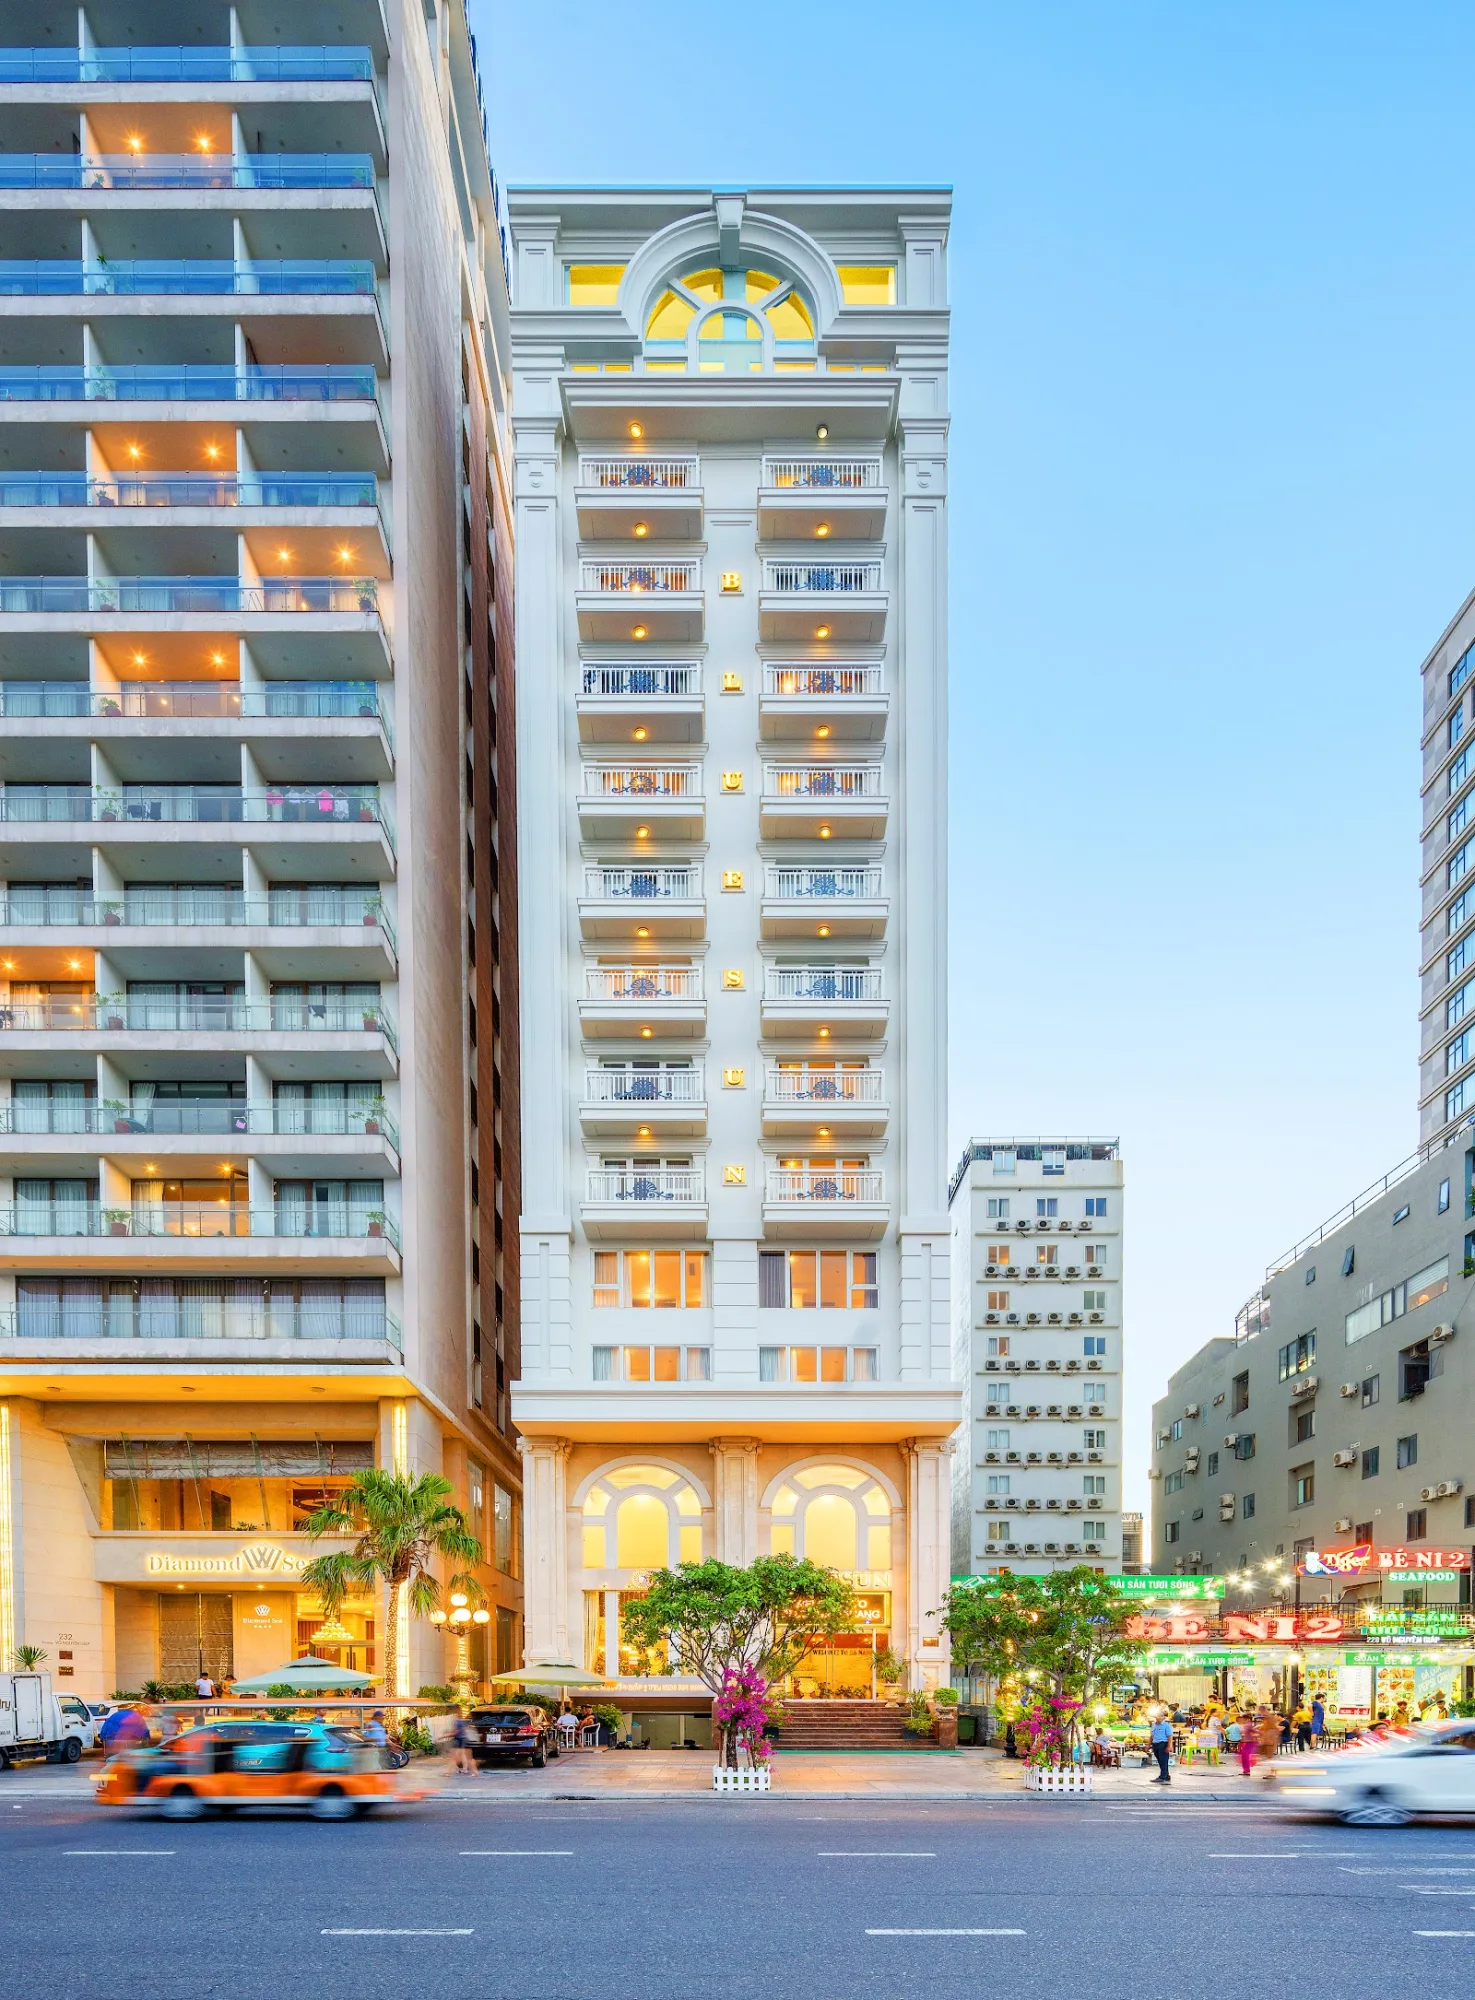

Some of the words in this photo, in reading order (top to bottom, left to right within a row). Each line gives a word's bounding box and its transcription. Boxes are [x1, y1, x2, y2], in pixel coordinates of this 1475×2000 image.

[149, 1555, 241, 1571] Diamond
[282, 1556, 309, 1571] Se
[1324, 1551, 1370, 1572] Tiger
[1378, 1548, 1408, 1568] BÉ
[1416, 1552, 1443, 1568] NI
[1449, 1552, 1465, 1568] 2
[1388, 1571, 1456, 1582] SEAFOOD
[1127, 1578, 1146, 1589] SẢN
[1411, 1609, 1456, 1622] SẢN
[1124, 1610, 1210, 1640] BÉ
[1224, 1615, 1299, 1641] NI
[1305, 1616, 1343, 1640] 2
[1411, 1624, 1469, 1636] SỐNG
[58, 1633, 73, 1641] 232
